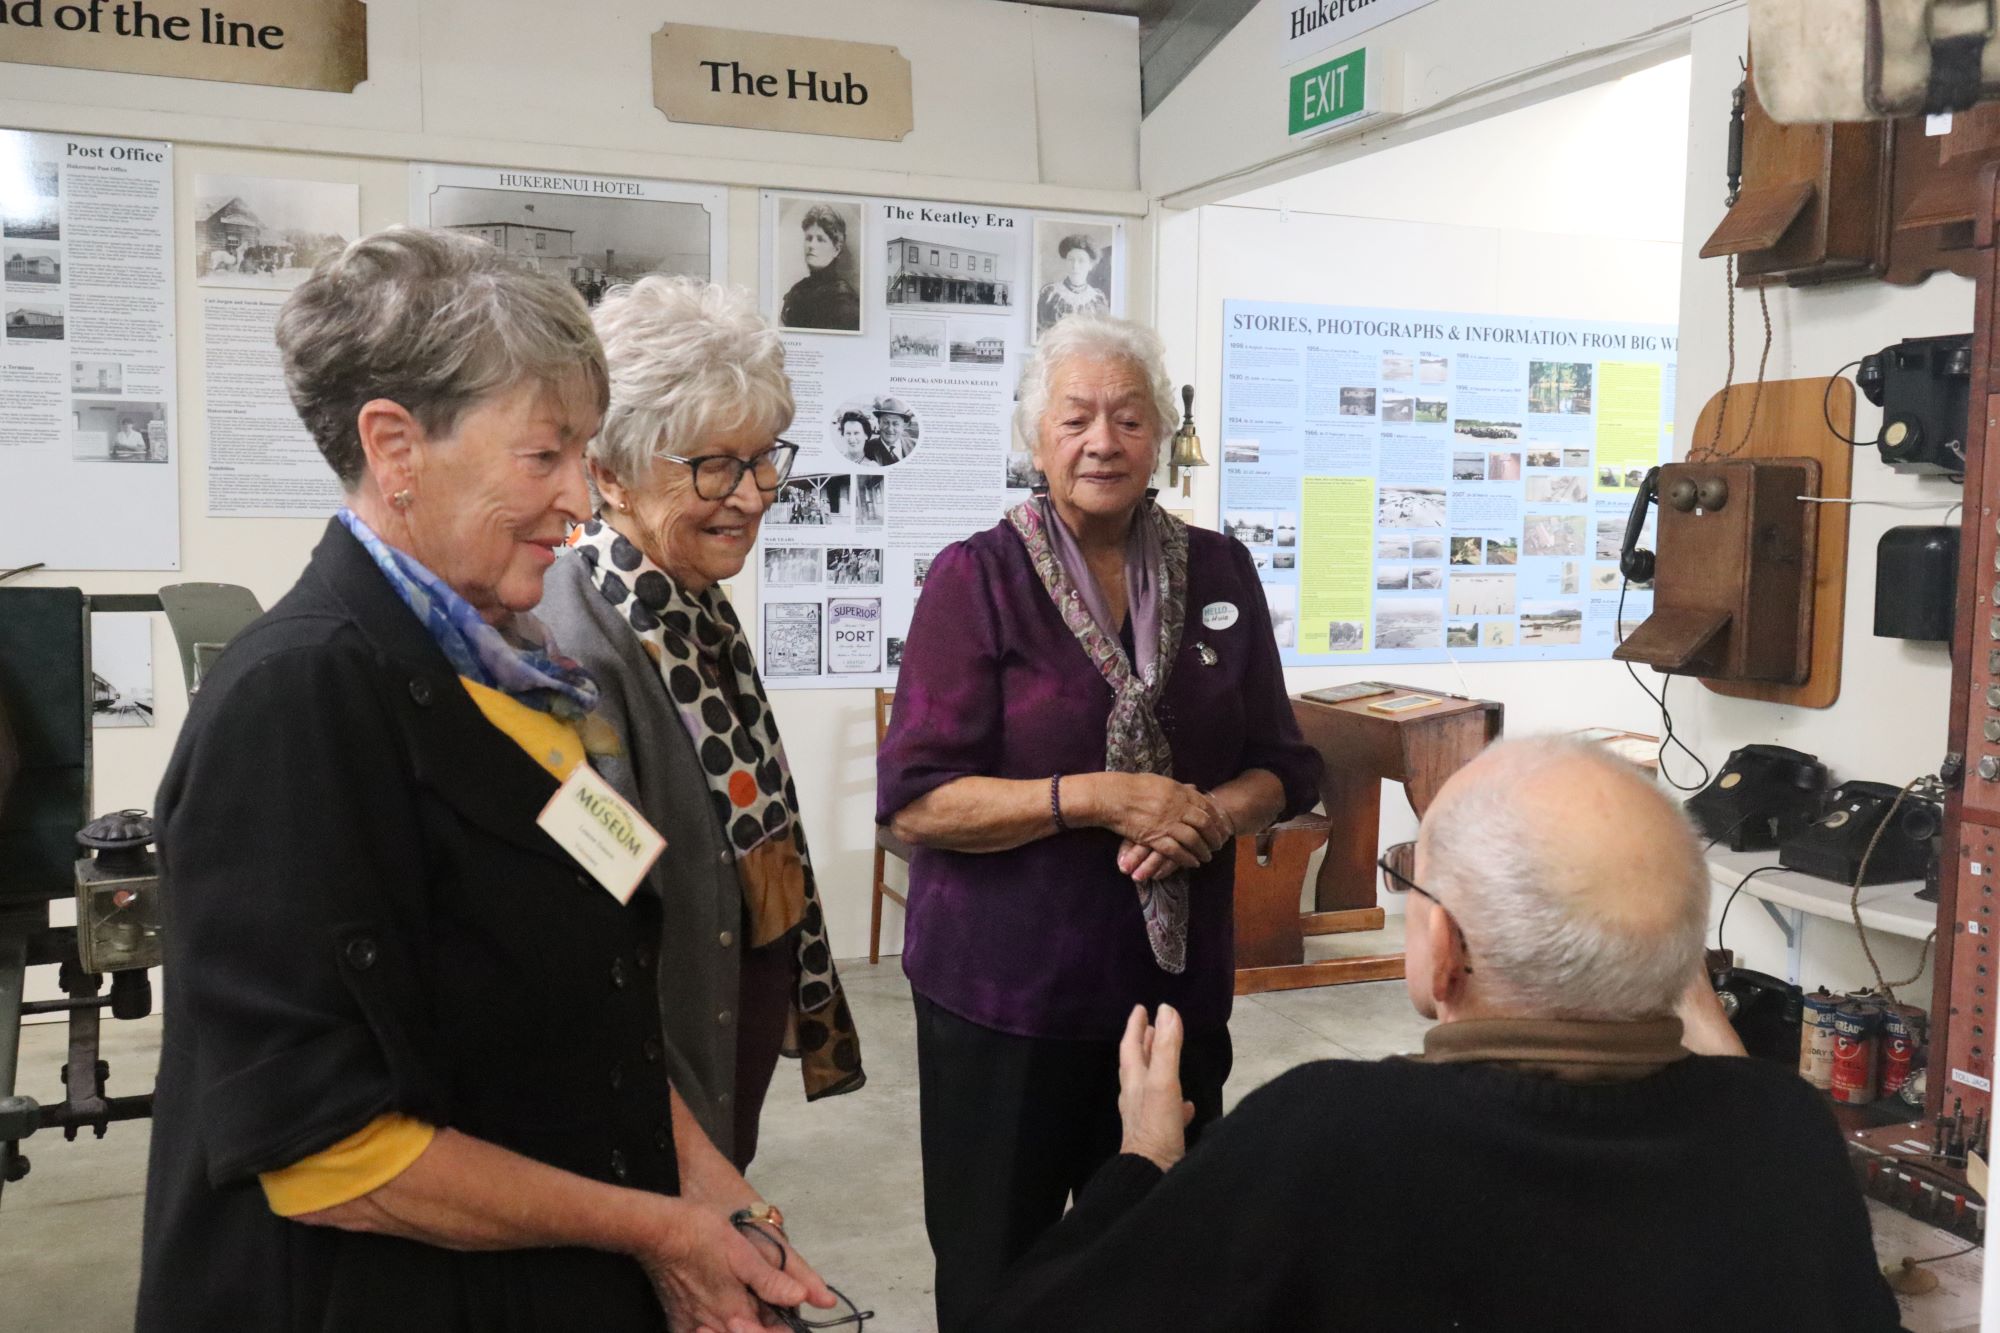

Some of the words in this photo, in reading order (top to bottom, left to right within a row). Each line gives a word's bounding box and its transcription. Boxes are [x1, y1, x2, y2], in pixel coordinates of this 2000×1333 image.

[54, 0, 104, 33] of
[113, 0, 190, 41] the
[200, 8, 284, 50] line
[700, 60, 778, 97] The
[786, 69, 868, 105] Hub
[1304, 65, 1349, 121] EXIT
[67, 143, 104, 158] Post
[111, 146, 163, 162] Office
[499, 174, 588, 192] HUKERENUI
[592, 180, 644, 195] HOTEL
[883, 205, 914, 221] The
[920, 208, 980, 228] Keatley
[986, 213, 1014, 228] Era
[1233, 314, 1312, 335] STORIES,
[1317, 318, 1444, 340] PHOTOGRAPHS
[1448, 325, 1461, 340] &
[1466, 326, 1578, 346] INFORMATION
[1582, 333, 1626, 349] FROM
[1631, 335, 1656, 350] BIG
[970, 379, 998, 387] KEATLEY
[834, 606, 877, 619] SUPERIOR
[836, 630, 875, 642] PORT
[576, 787, 641, 856] MUSEUM
